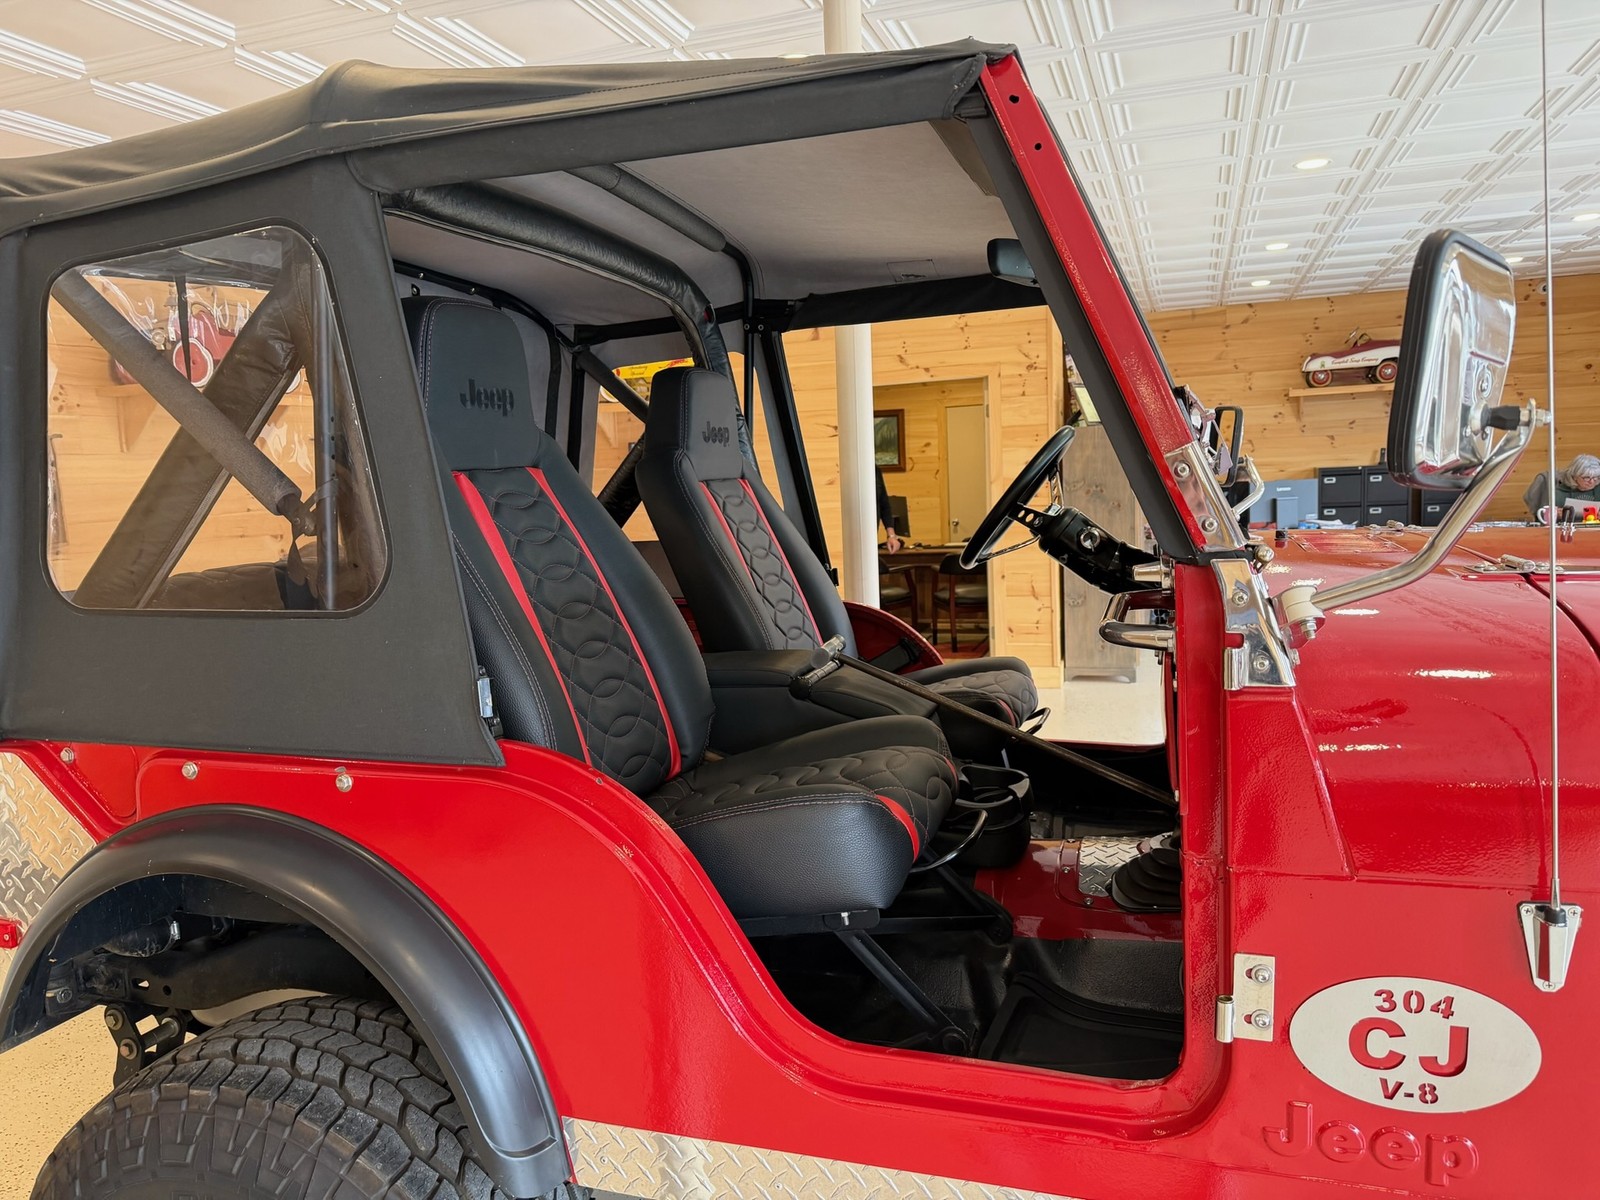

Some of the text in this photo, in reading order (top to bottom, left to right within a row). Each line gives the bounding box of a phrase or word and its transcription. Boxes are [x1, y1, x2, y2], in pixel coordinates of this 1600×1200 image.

[459, 378, 515, 417] Jeep
[701, 420, 730, 448] Jeep
[1374, 988, 1455, 1020] 304
[1348, 1016, 1470, 1078] CJ
[1379, 1077, 1439, 1105] V-8
[1262, 1099, 1479, 1187] Jeep
